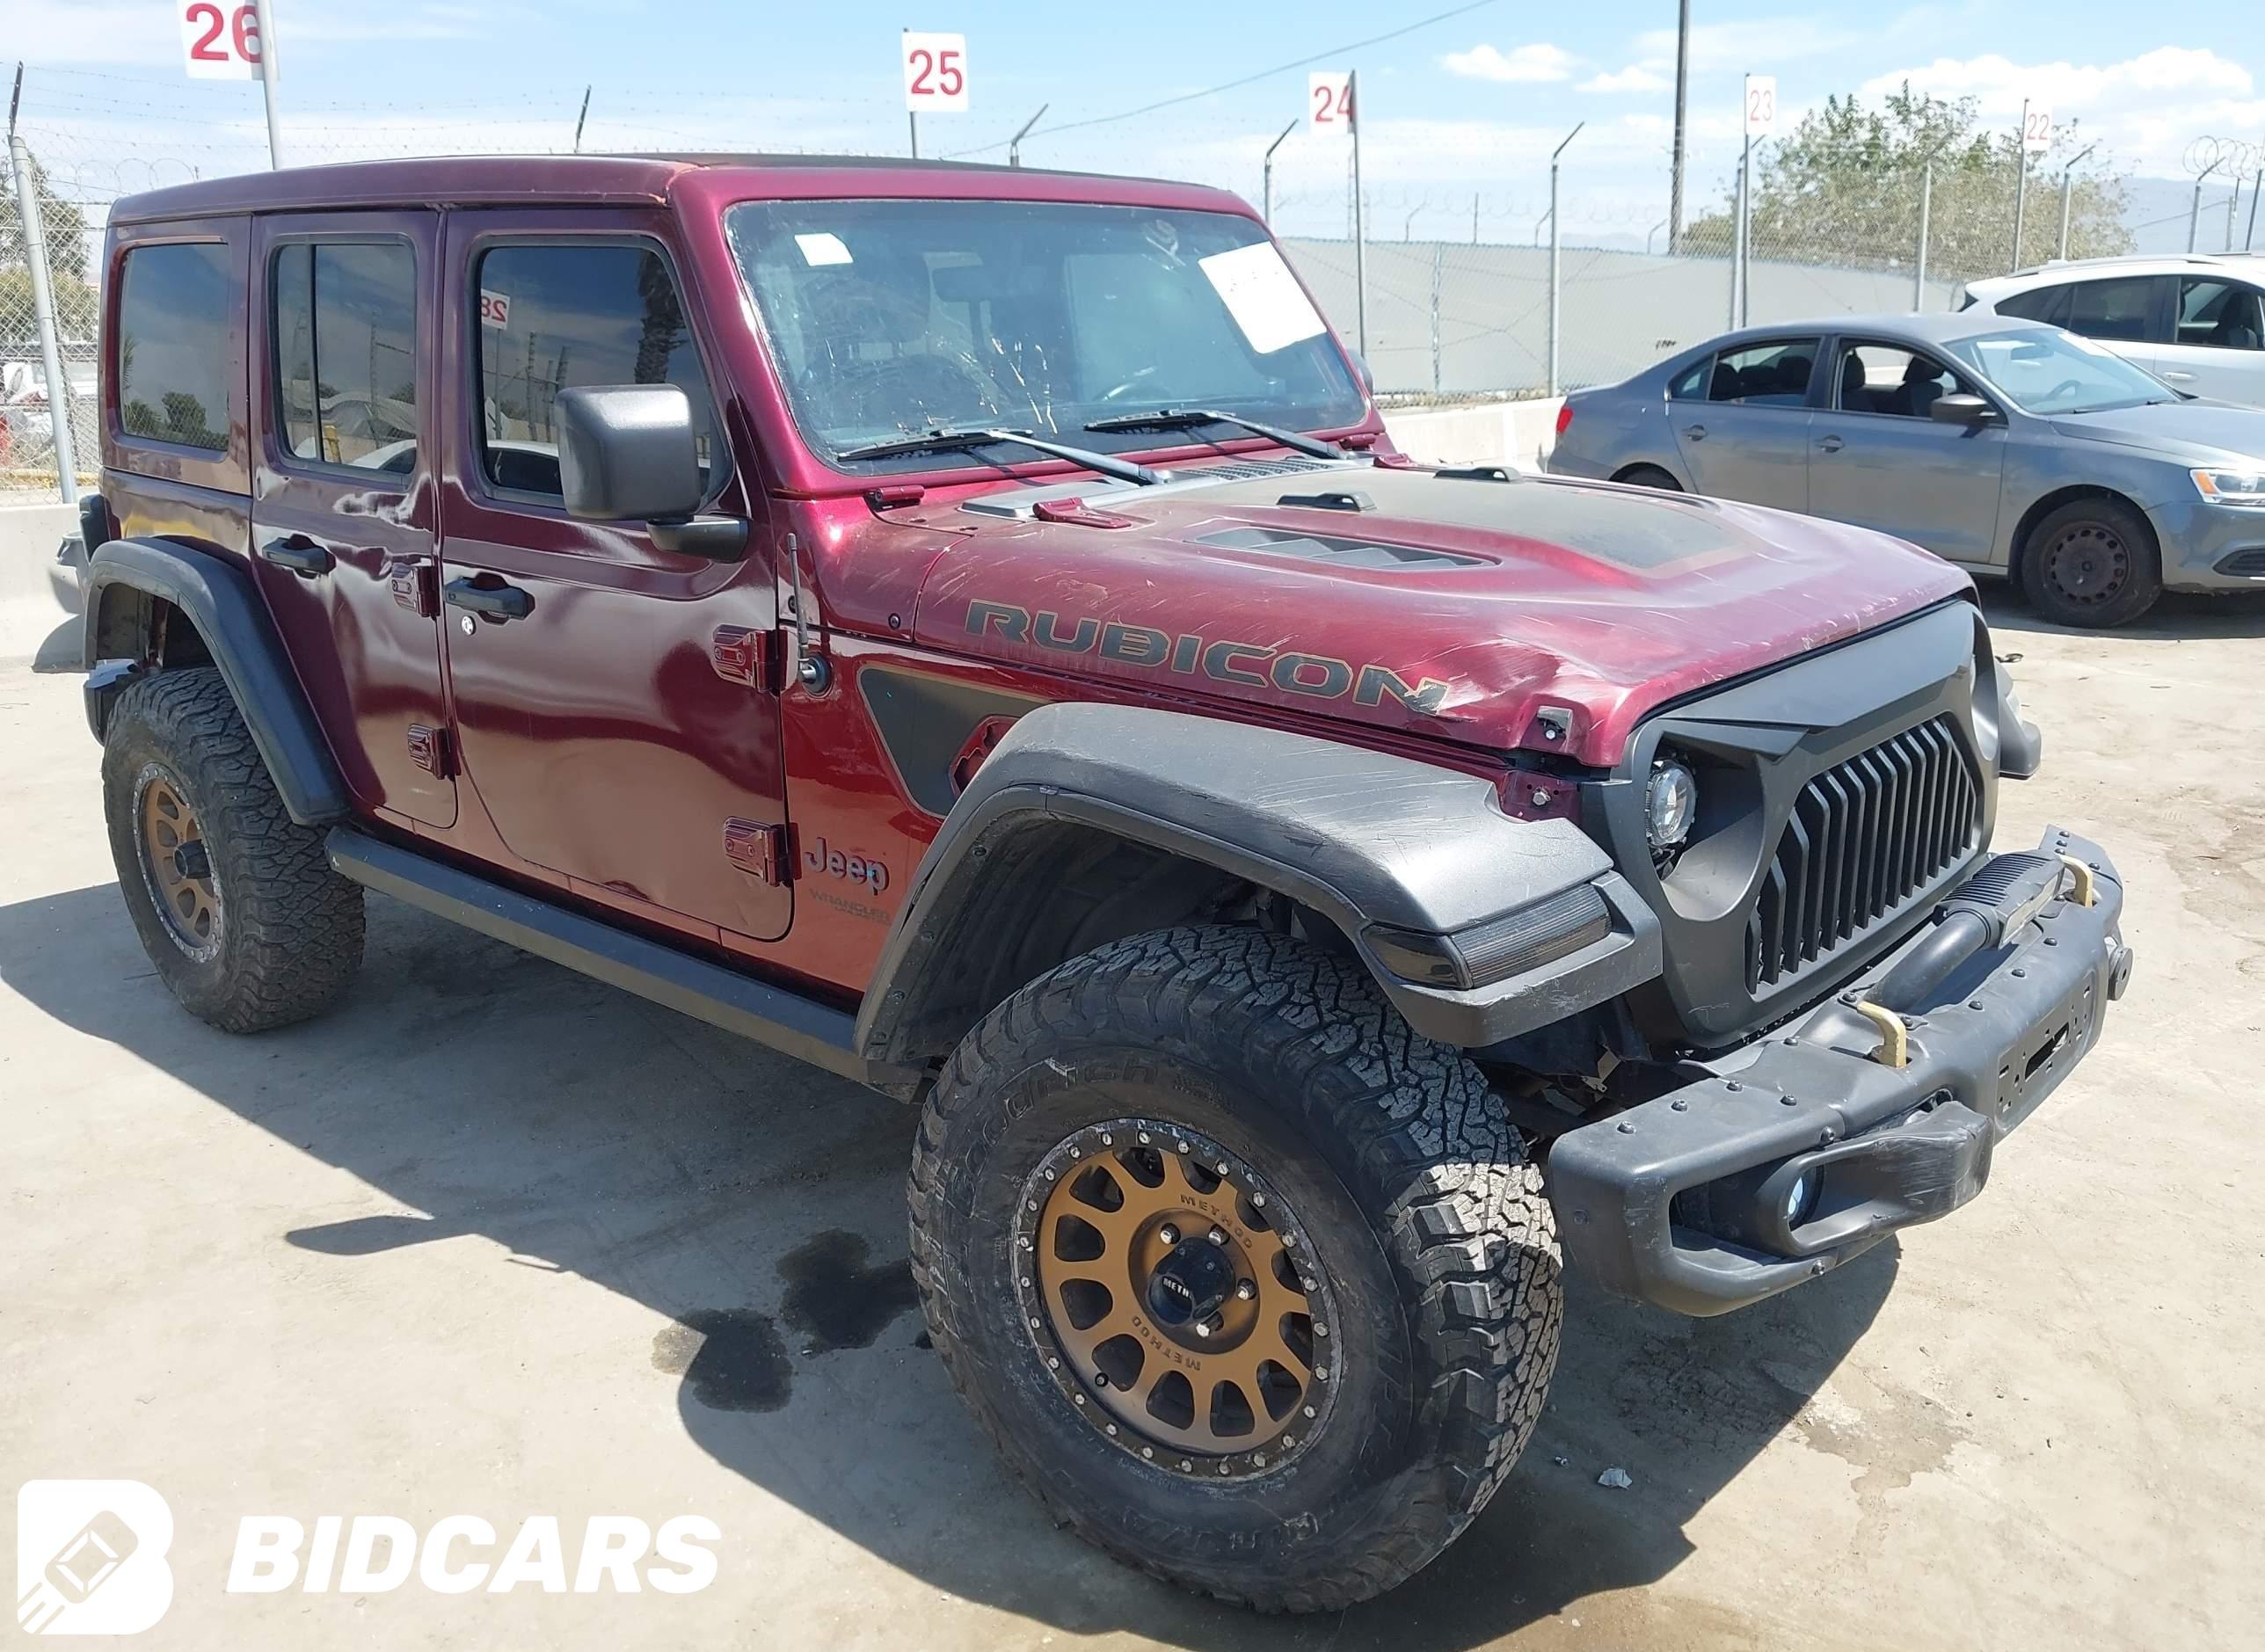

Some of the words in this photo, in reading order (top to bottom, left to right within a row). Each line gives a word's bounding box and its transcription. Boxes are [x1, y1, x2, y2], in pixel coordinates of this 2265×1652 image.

[186, 3, 262, 63] 26
[909, 49, 963, 96] 25
[1315, 85, 1355, 122] 24
[1750, 90, 1773, 121] 23
[2027, 113, 2049, 140] 22
[965, 599, 1450, 715] RUBICON
[804, 836, 890, 896] Jeep
[1180, 1193, 1253, 1248] METHOD
[1162, 1277, 1191, 1299] METH
[1132, 1315, 1202, 1372] METHOD
